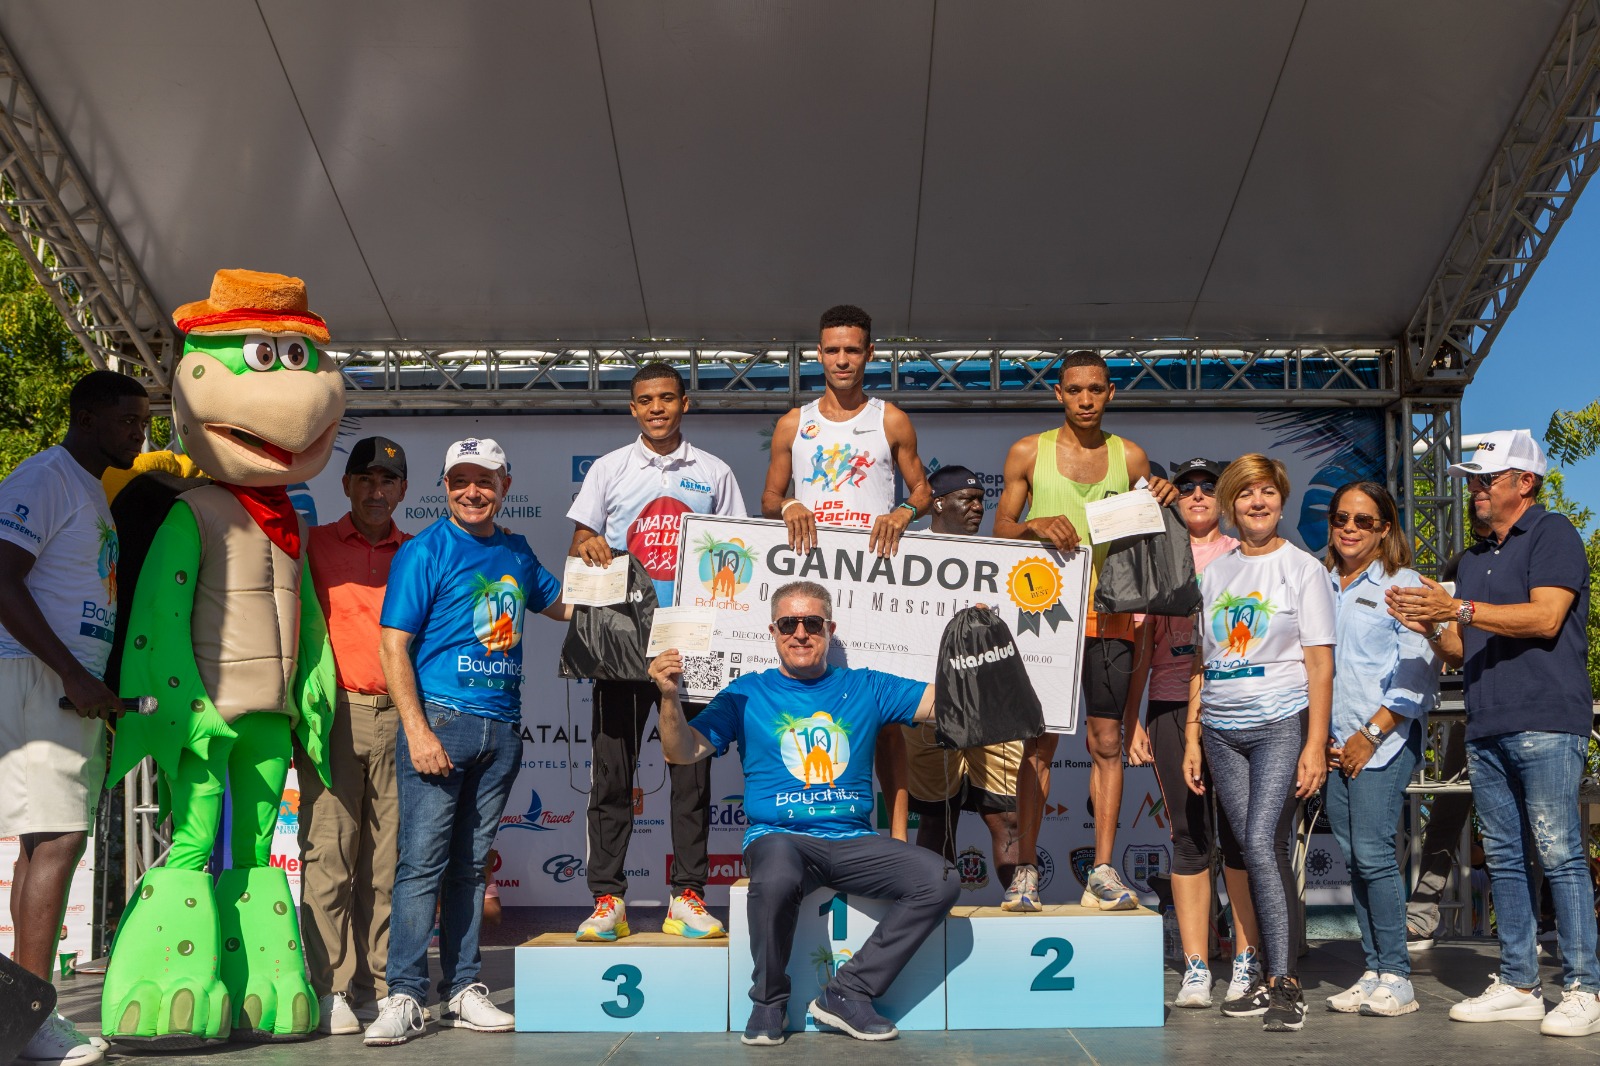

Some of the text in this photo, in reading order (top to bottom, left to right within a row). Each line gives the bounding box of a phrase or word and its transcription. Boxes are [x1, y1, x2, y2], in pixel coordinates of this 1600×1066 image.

[501, 495, 529, 503] OTELES
[814, 500, 844, 511] Los
[405, 507, 450, 519] ROMA
[813, 509, 871, 523] Racing
[634, 514, 681, 534] MARU
[765, 543, 1000, 594] GANADOR
[1024, 572, 1034, 591] 1
[1031, 588, 1049, 598] BEST
[871, 591, 1000, 618] Masculi
[732, 630, 774, 641] DIECIOCH
[863, 641, 909, 652] CENTAVOS
[746, 654, 781, 665] @Bayahi
[949, 641, 1015, 671] vitasalud
[1022, 654, 1053, 665] 000.00
[520, 760, 567, 769] HOTELS
[775, 788, 859, 807] Bayahibe
[541, 810, 575, 826] Travel
[709, 803, 748, 826] Edé
[787, 804, 856, 819] 2024
[1040, 851, 1053, 874] CIVIL
[623, 868, 650, 877] anela
[818, 891, 848, 941] 1
[1029, 936, 1075, 991] 2
[600, 963, 645, 1019] 3
